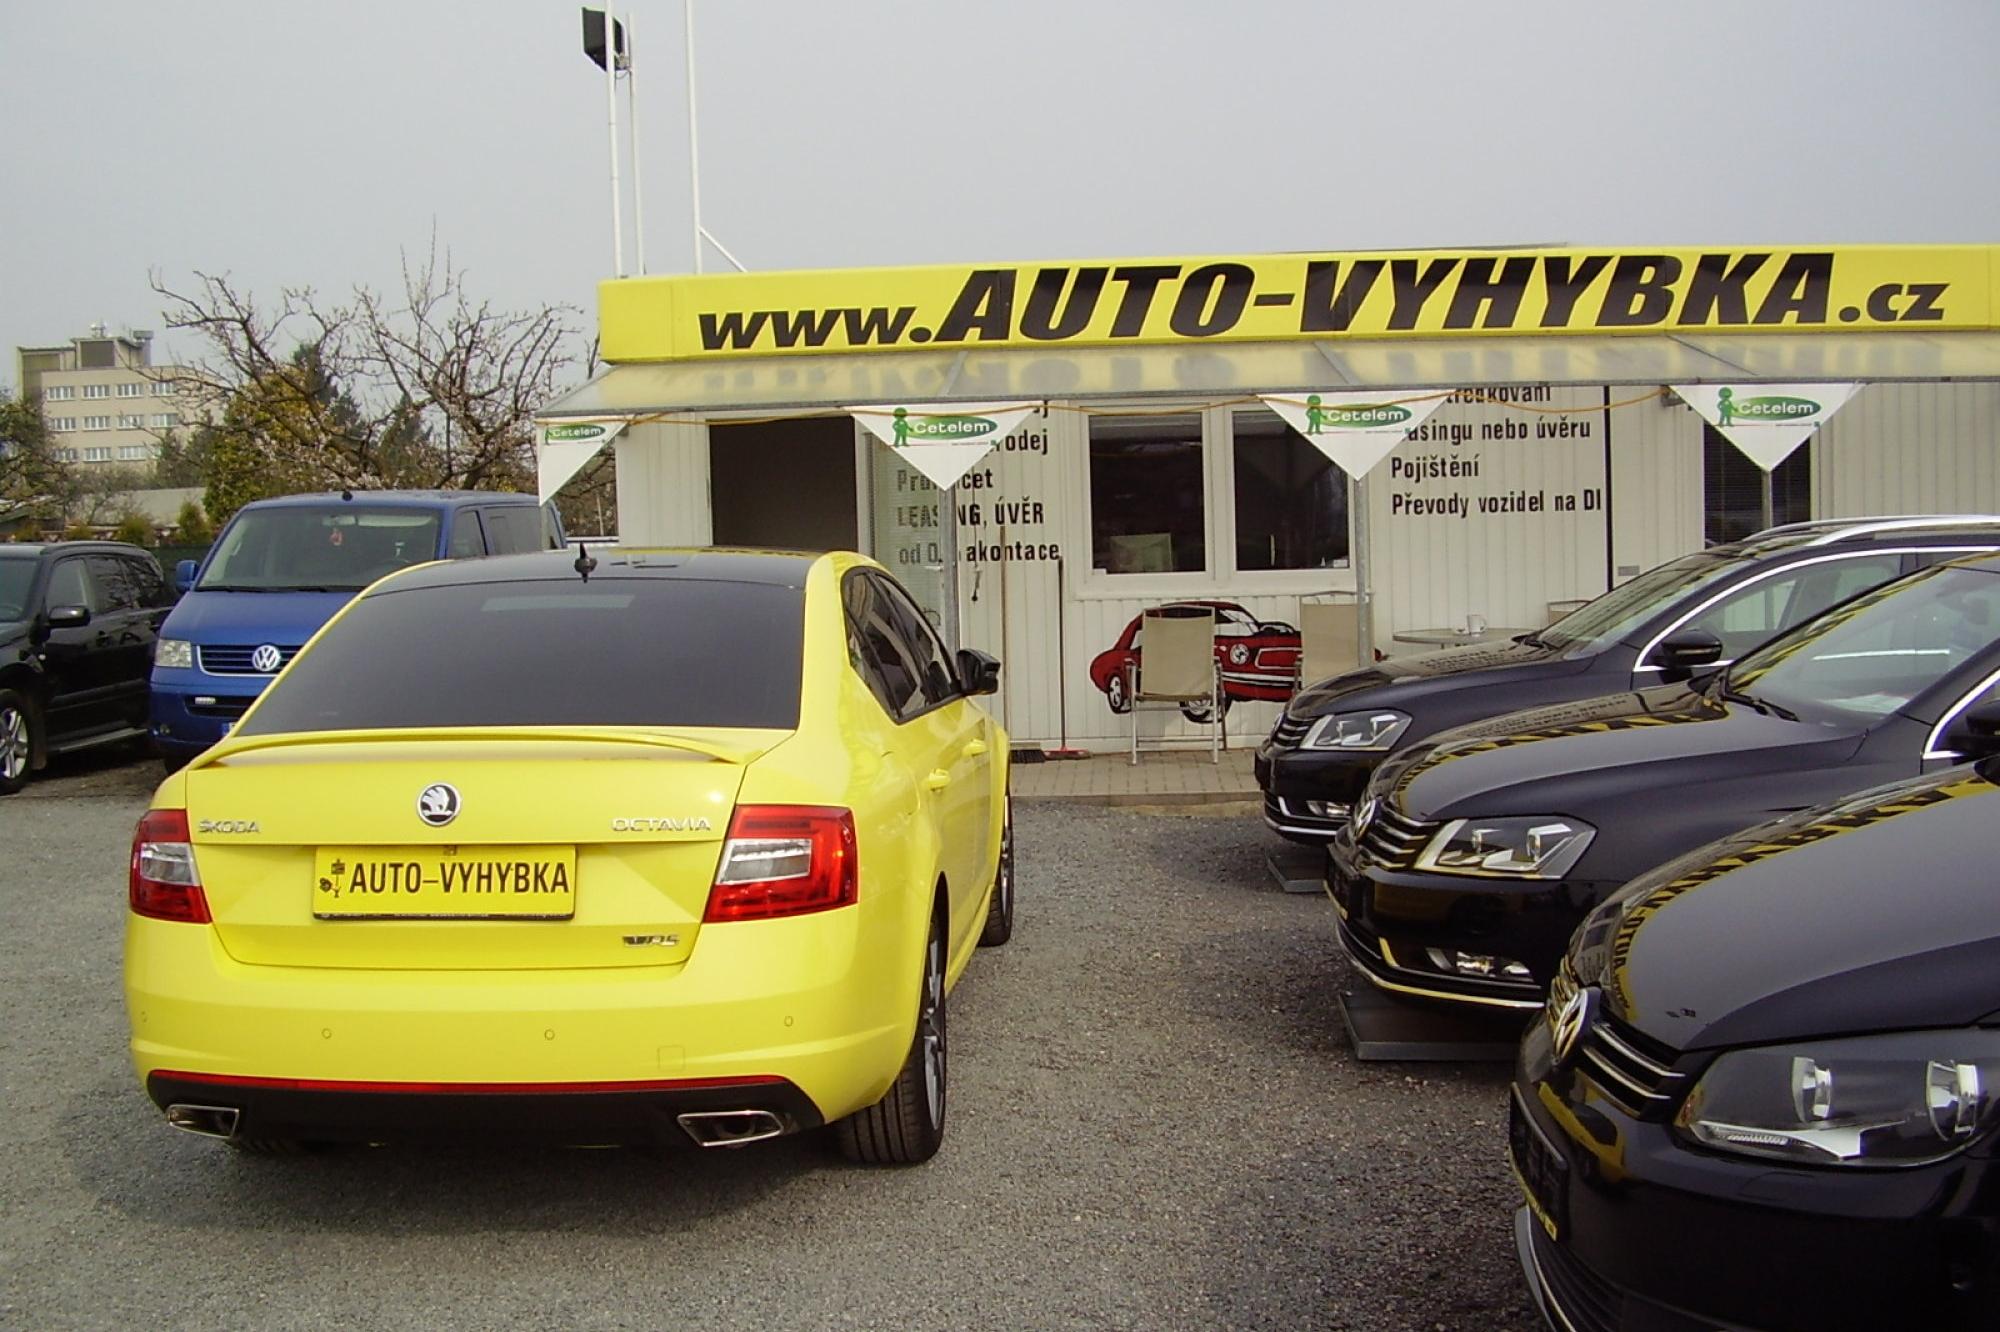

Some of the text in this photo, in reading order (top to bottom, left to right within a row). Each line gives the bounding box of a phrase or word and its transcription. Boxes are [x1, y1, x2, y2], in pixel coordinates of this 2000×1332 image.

[697, 252, 1950, 352] www.AUTO-VYHYBKA.cz
[1328, 409, 1404, 421] Cetelem
[1738, 401, 1813, 415] Cetelem
[914, 420, 990, 433] Cetelem
[1482, 417, 1528, 441] nebo
[1536, 415, 1591, 439] úvěru
[1391, 453, 1480, 483] Pojištění
[995, 496, 1044, 525] ÚVĚR
[1392, 492, 1469, 519] Převody
[1478, 489, 1544, 513] vozidel
[1554, 494, 1576, 511] na
[899, 543, 921, 564] od
[966, 540, 1060, 562] akontace
[611, 817, 712, 832] OCTAVIA
[349, 862, 570, 894] AUTO-VYHYBKA
